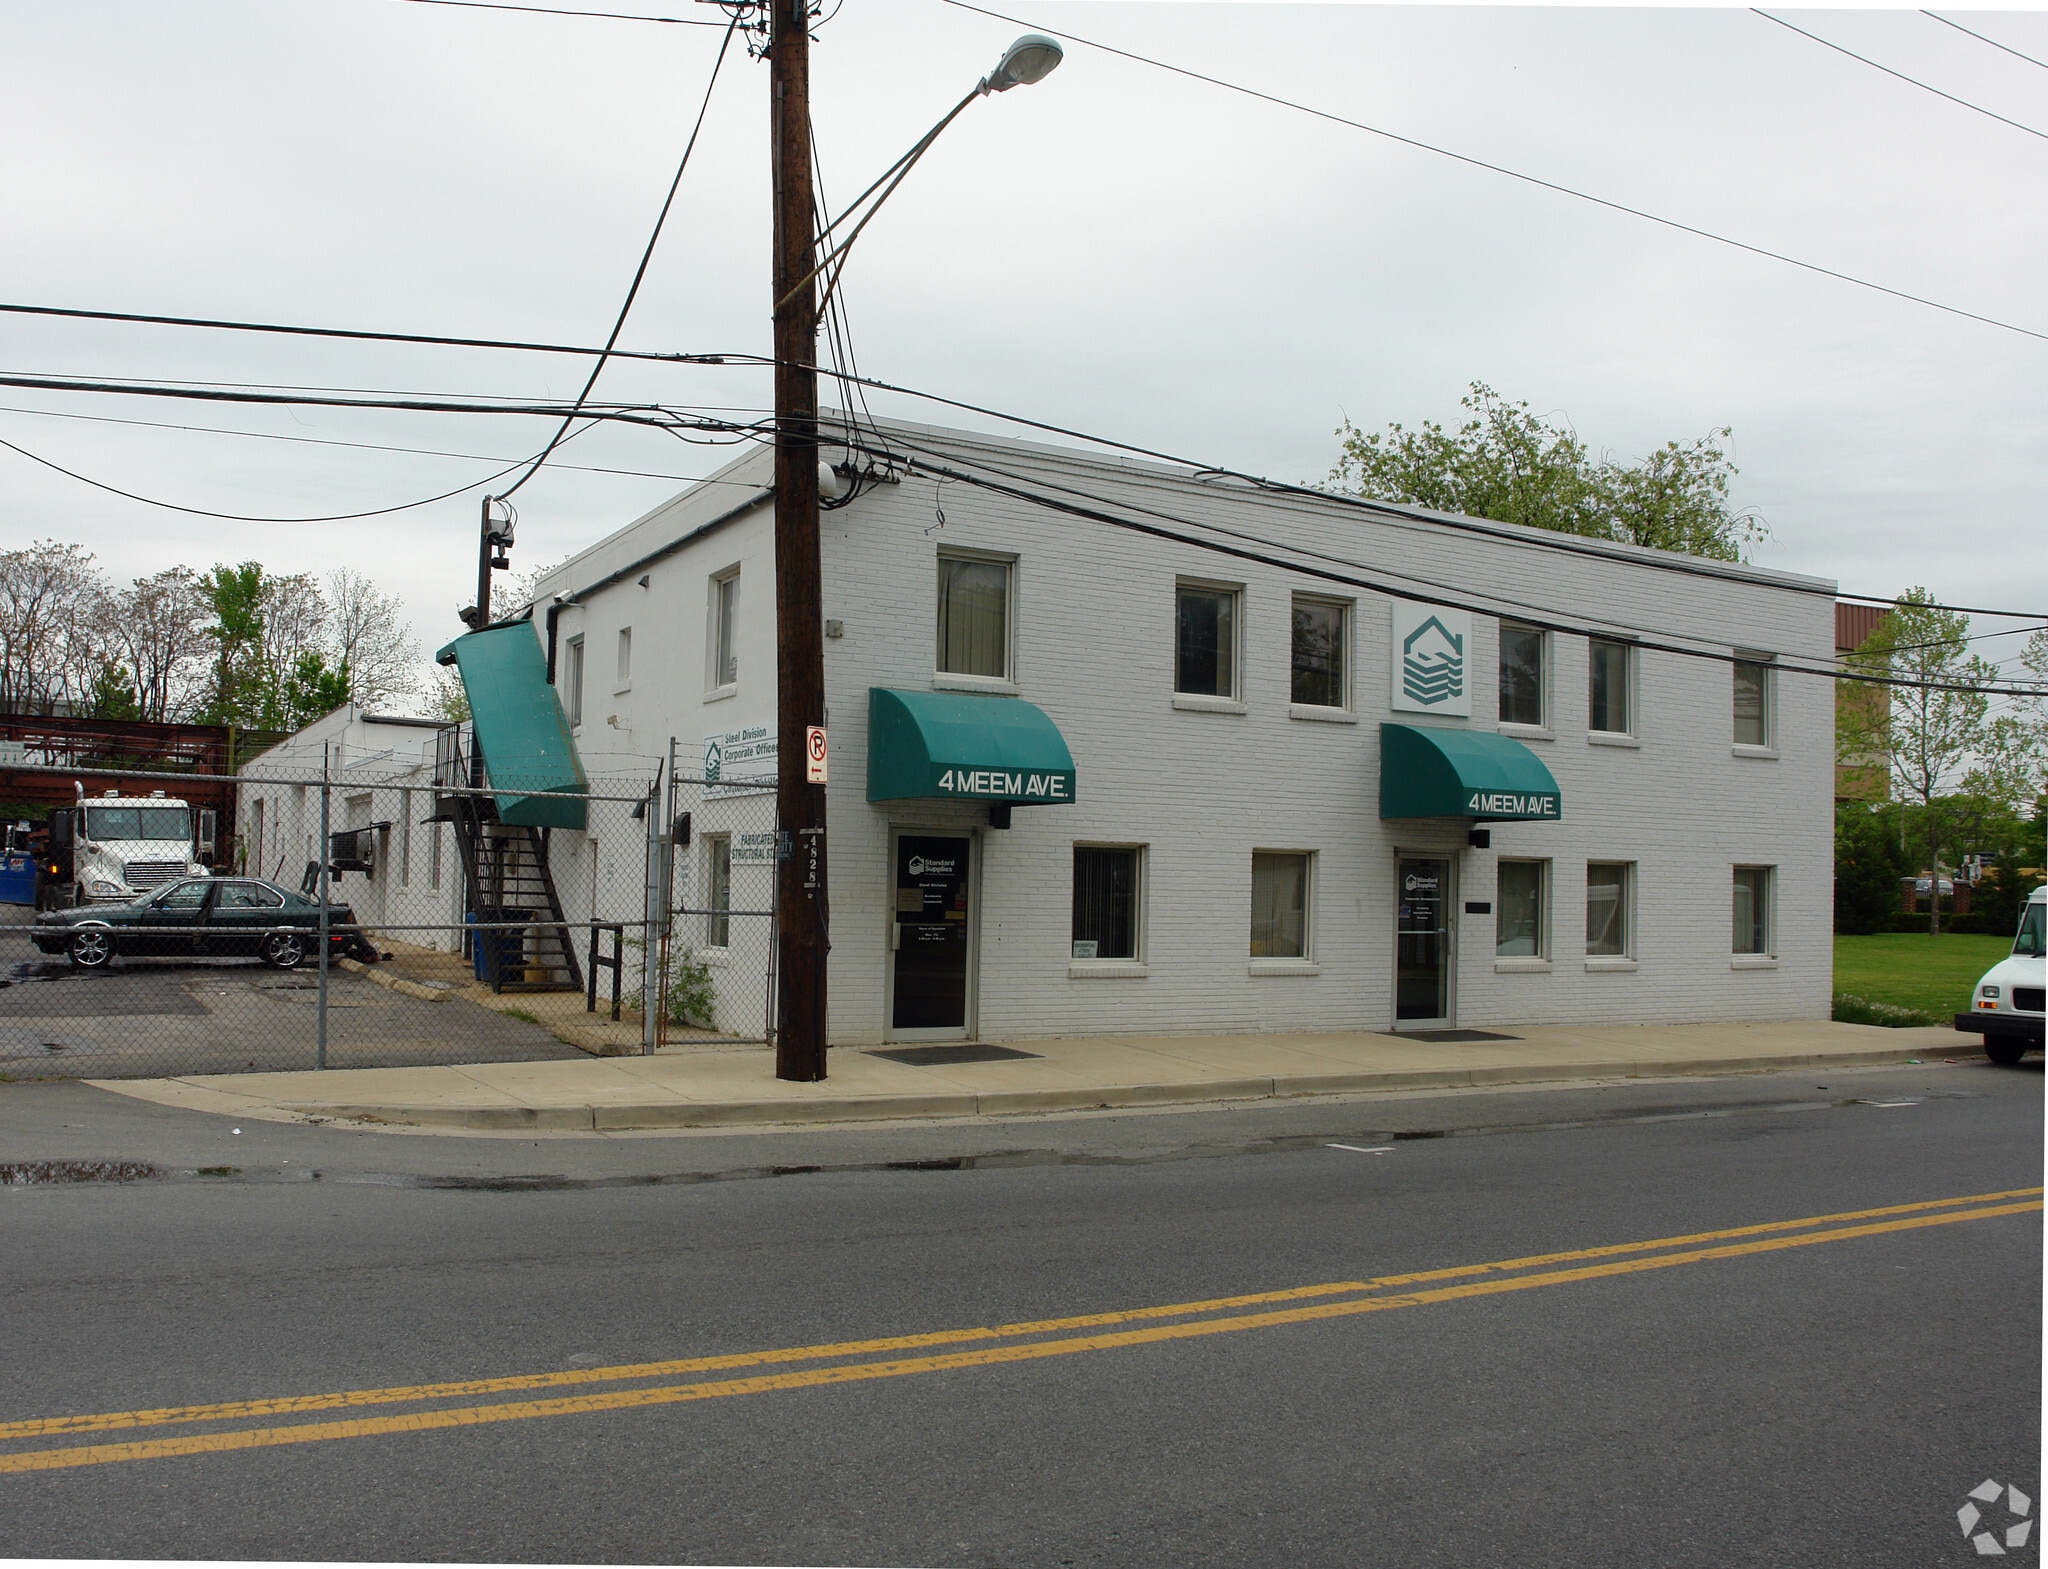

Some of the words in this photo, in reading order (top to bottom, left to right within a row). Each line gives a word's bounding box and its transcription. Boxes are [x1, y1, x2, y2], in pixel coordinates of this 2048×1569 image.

[725, 730, 741, 744] Steel
[742, 727, 767, 741] Division
[814, 735, 823, 755] P
[724, 747, 754, 761] Corporate
[755, 743, 779, 756] Offices
[938, 769, 954, 791] 4
[957, 770, 1022, 795] MEEM
[1025, 774, 1069, 798] AVE.
[1468, 793, 1480, 811] 4
[1481, 793, 1526, 814] MEEM
[1526, 795, 1557, 815] AVE.
[740, 833, 774, 846] FABRICATED
[731, 848, 765, 860] STRUCTURAL
[808, 834, 818, 882] 4828
